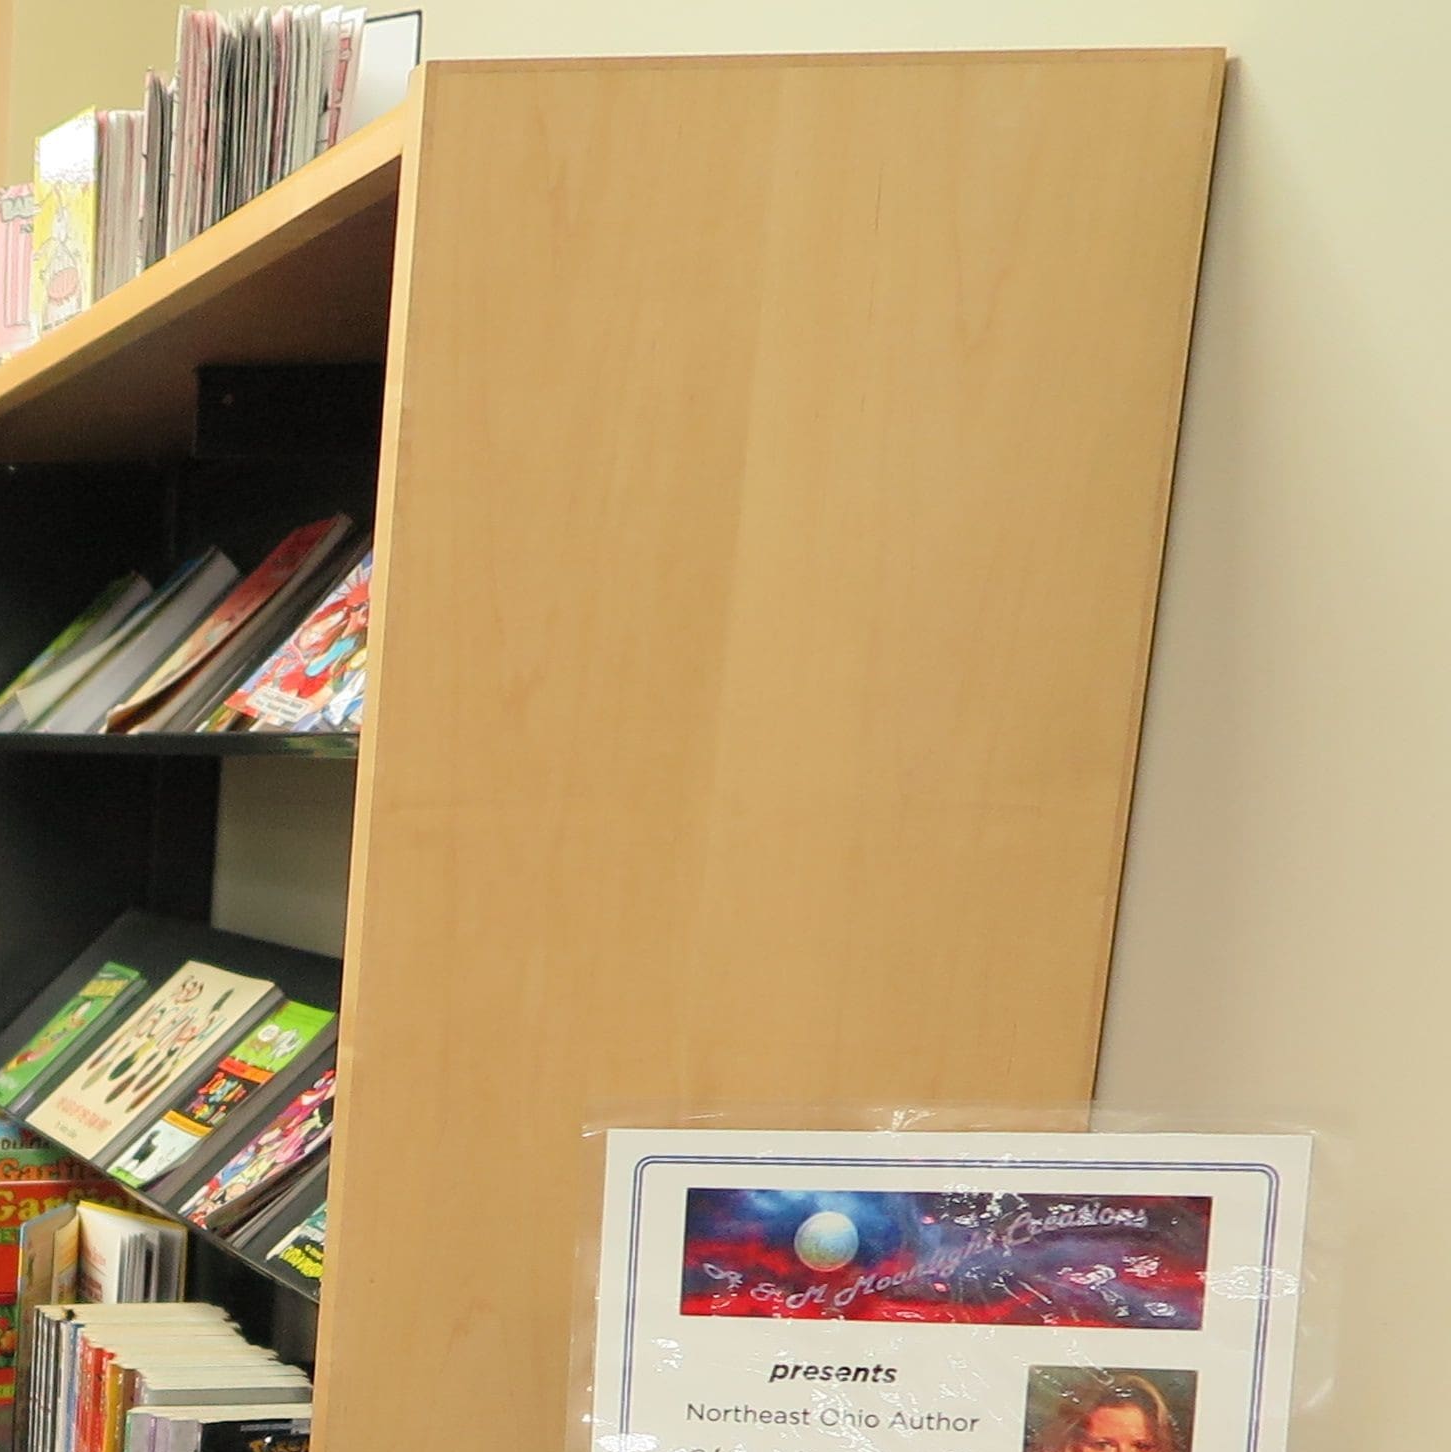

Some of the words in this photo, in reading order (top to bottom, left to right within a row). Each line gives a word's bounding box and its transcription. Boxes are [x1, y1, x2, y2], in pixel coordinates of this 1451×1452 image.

[767, 1361, 898, 1386] presents
[686, 1403, 812, 1426] Northeast
[819, 1408, 883, 1429] Ohio
[887, 1410, 980, 1433] Author
